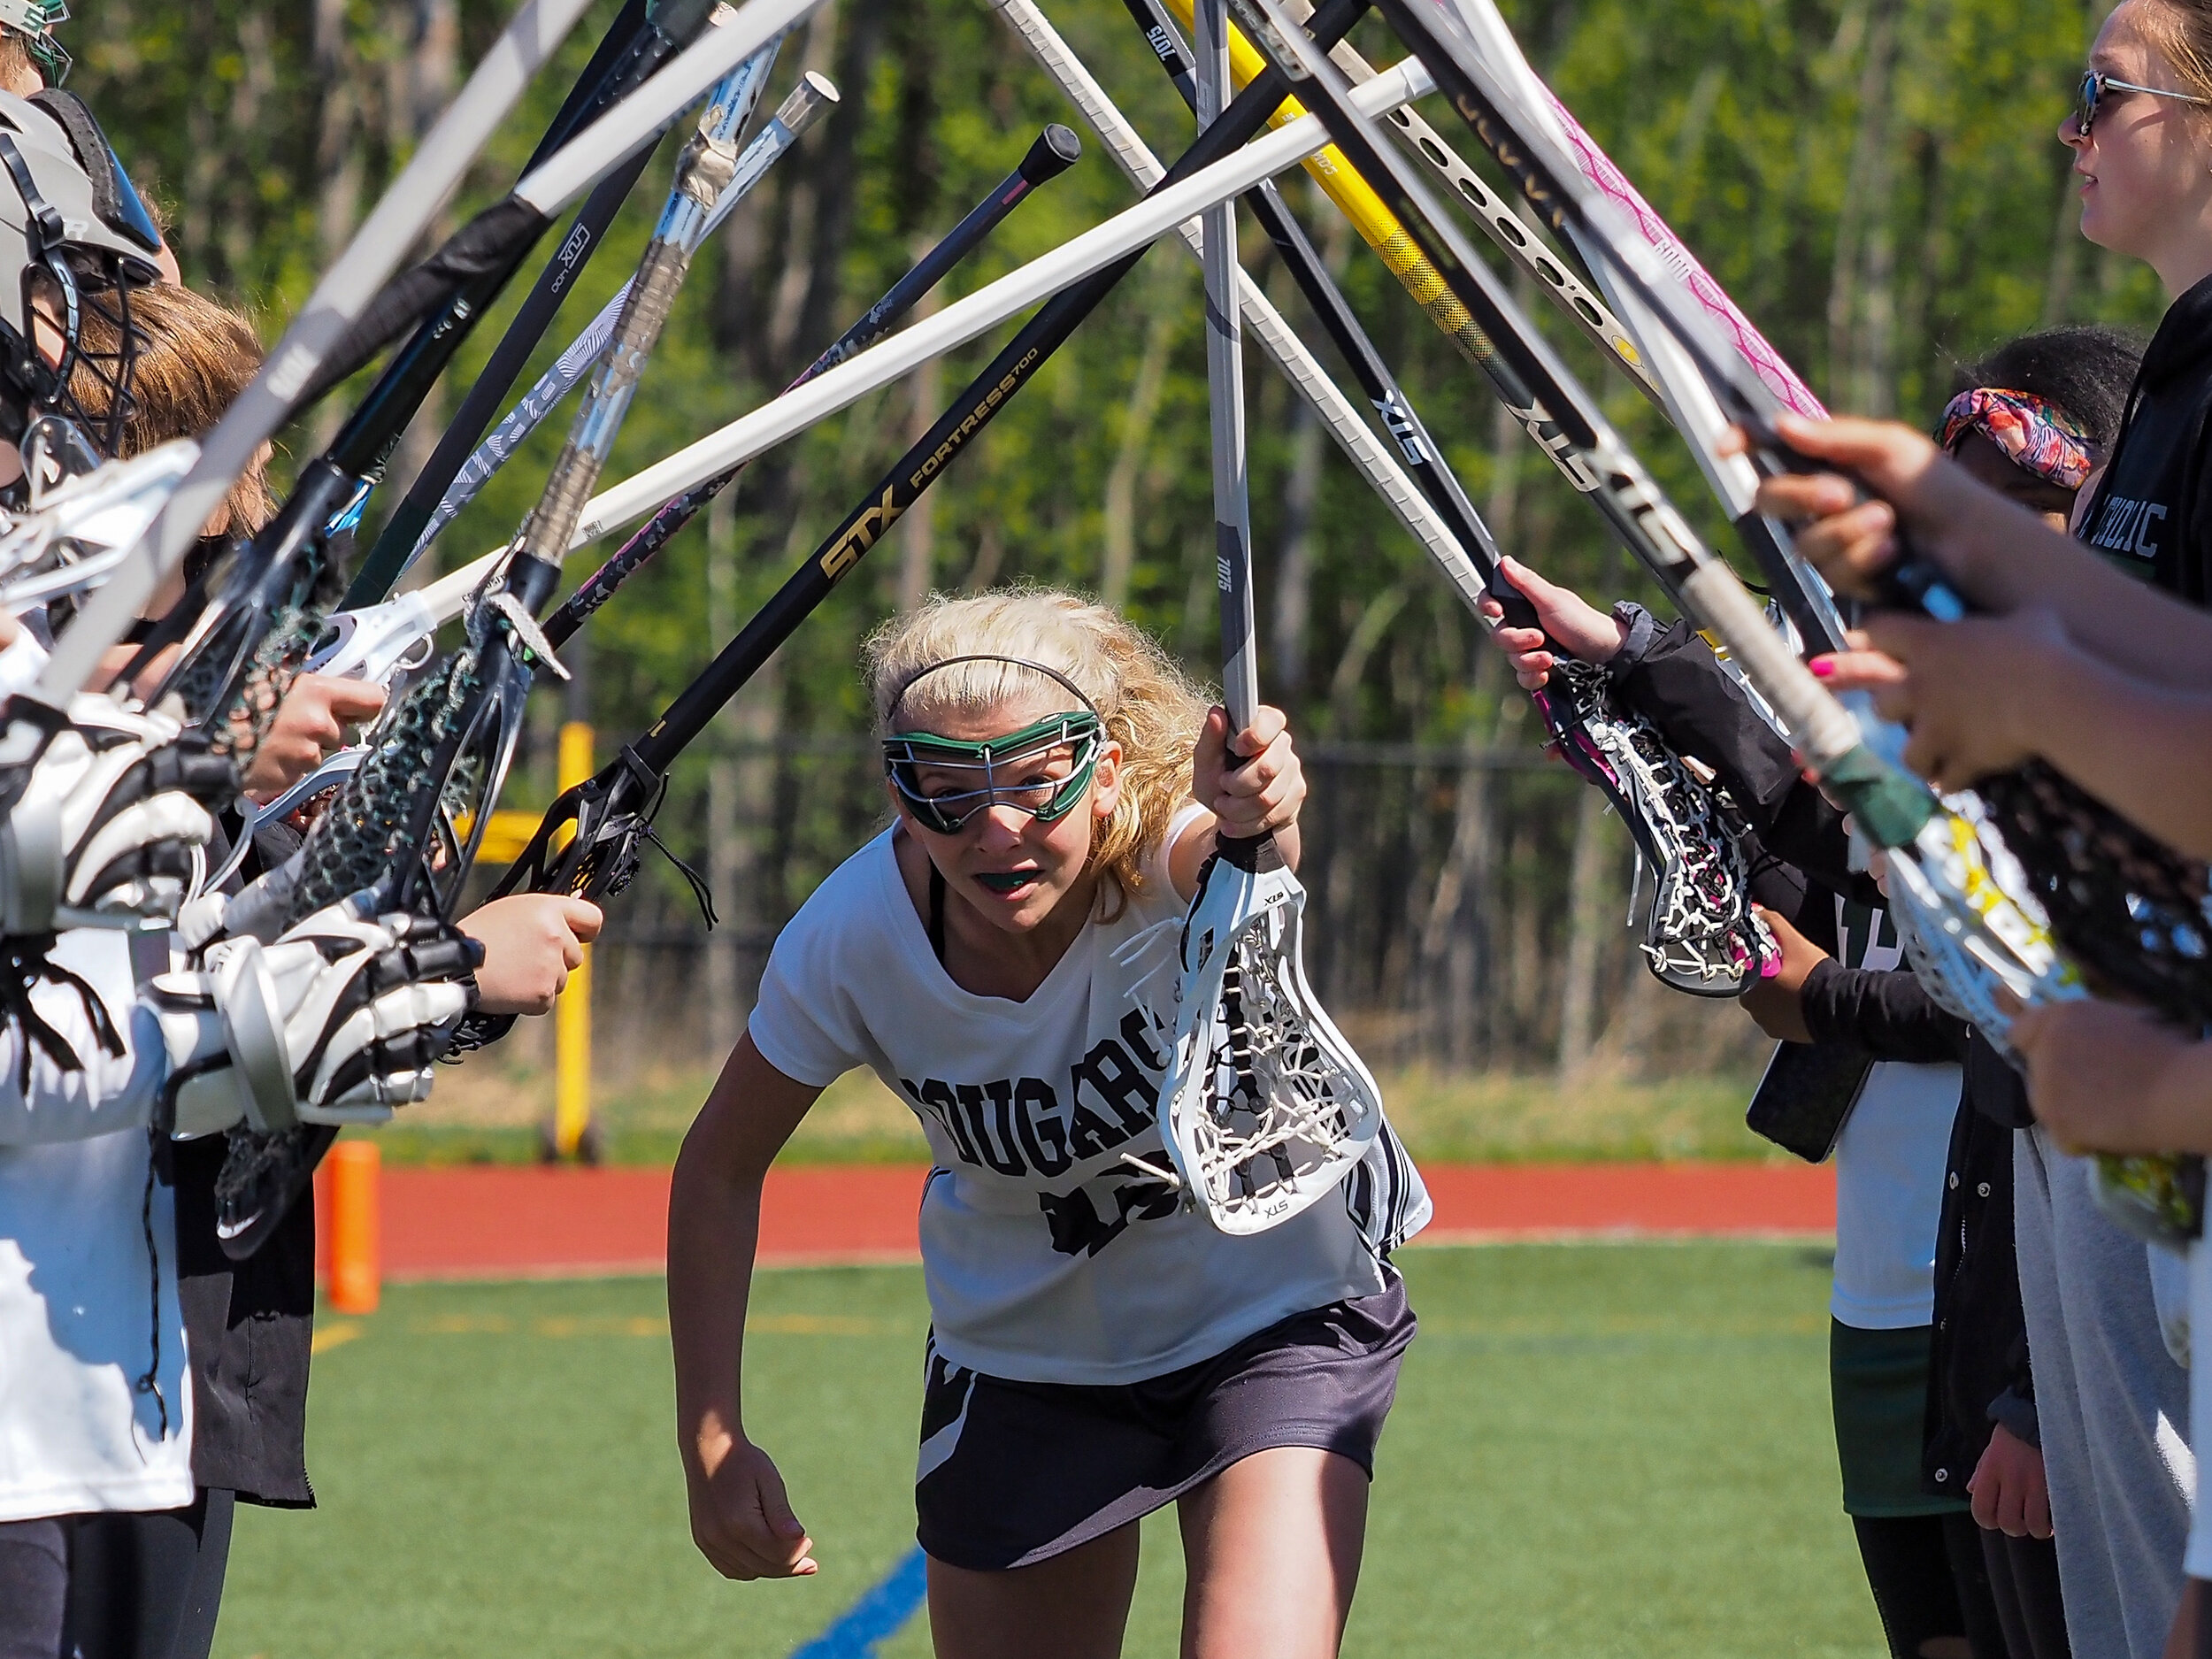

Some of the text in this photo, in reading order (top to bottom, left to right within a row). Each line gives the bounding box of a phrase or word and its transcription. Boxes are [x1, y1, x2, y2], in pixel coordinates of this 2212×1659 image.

[1147, 26, 1177, 61] 7075
[550, 268, 569, 293] 400
[1370, 388, 1432, 466] STX
[1504, 397, 1601, 493] STX
[819, 347, 1039, 580] STX FORTRESS 700
[1217, 555, 1233, 593] 7075
[1264, 891, 1284, 906] STX
[1263, 1200, 1289, 1219] STX
